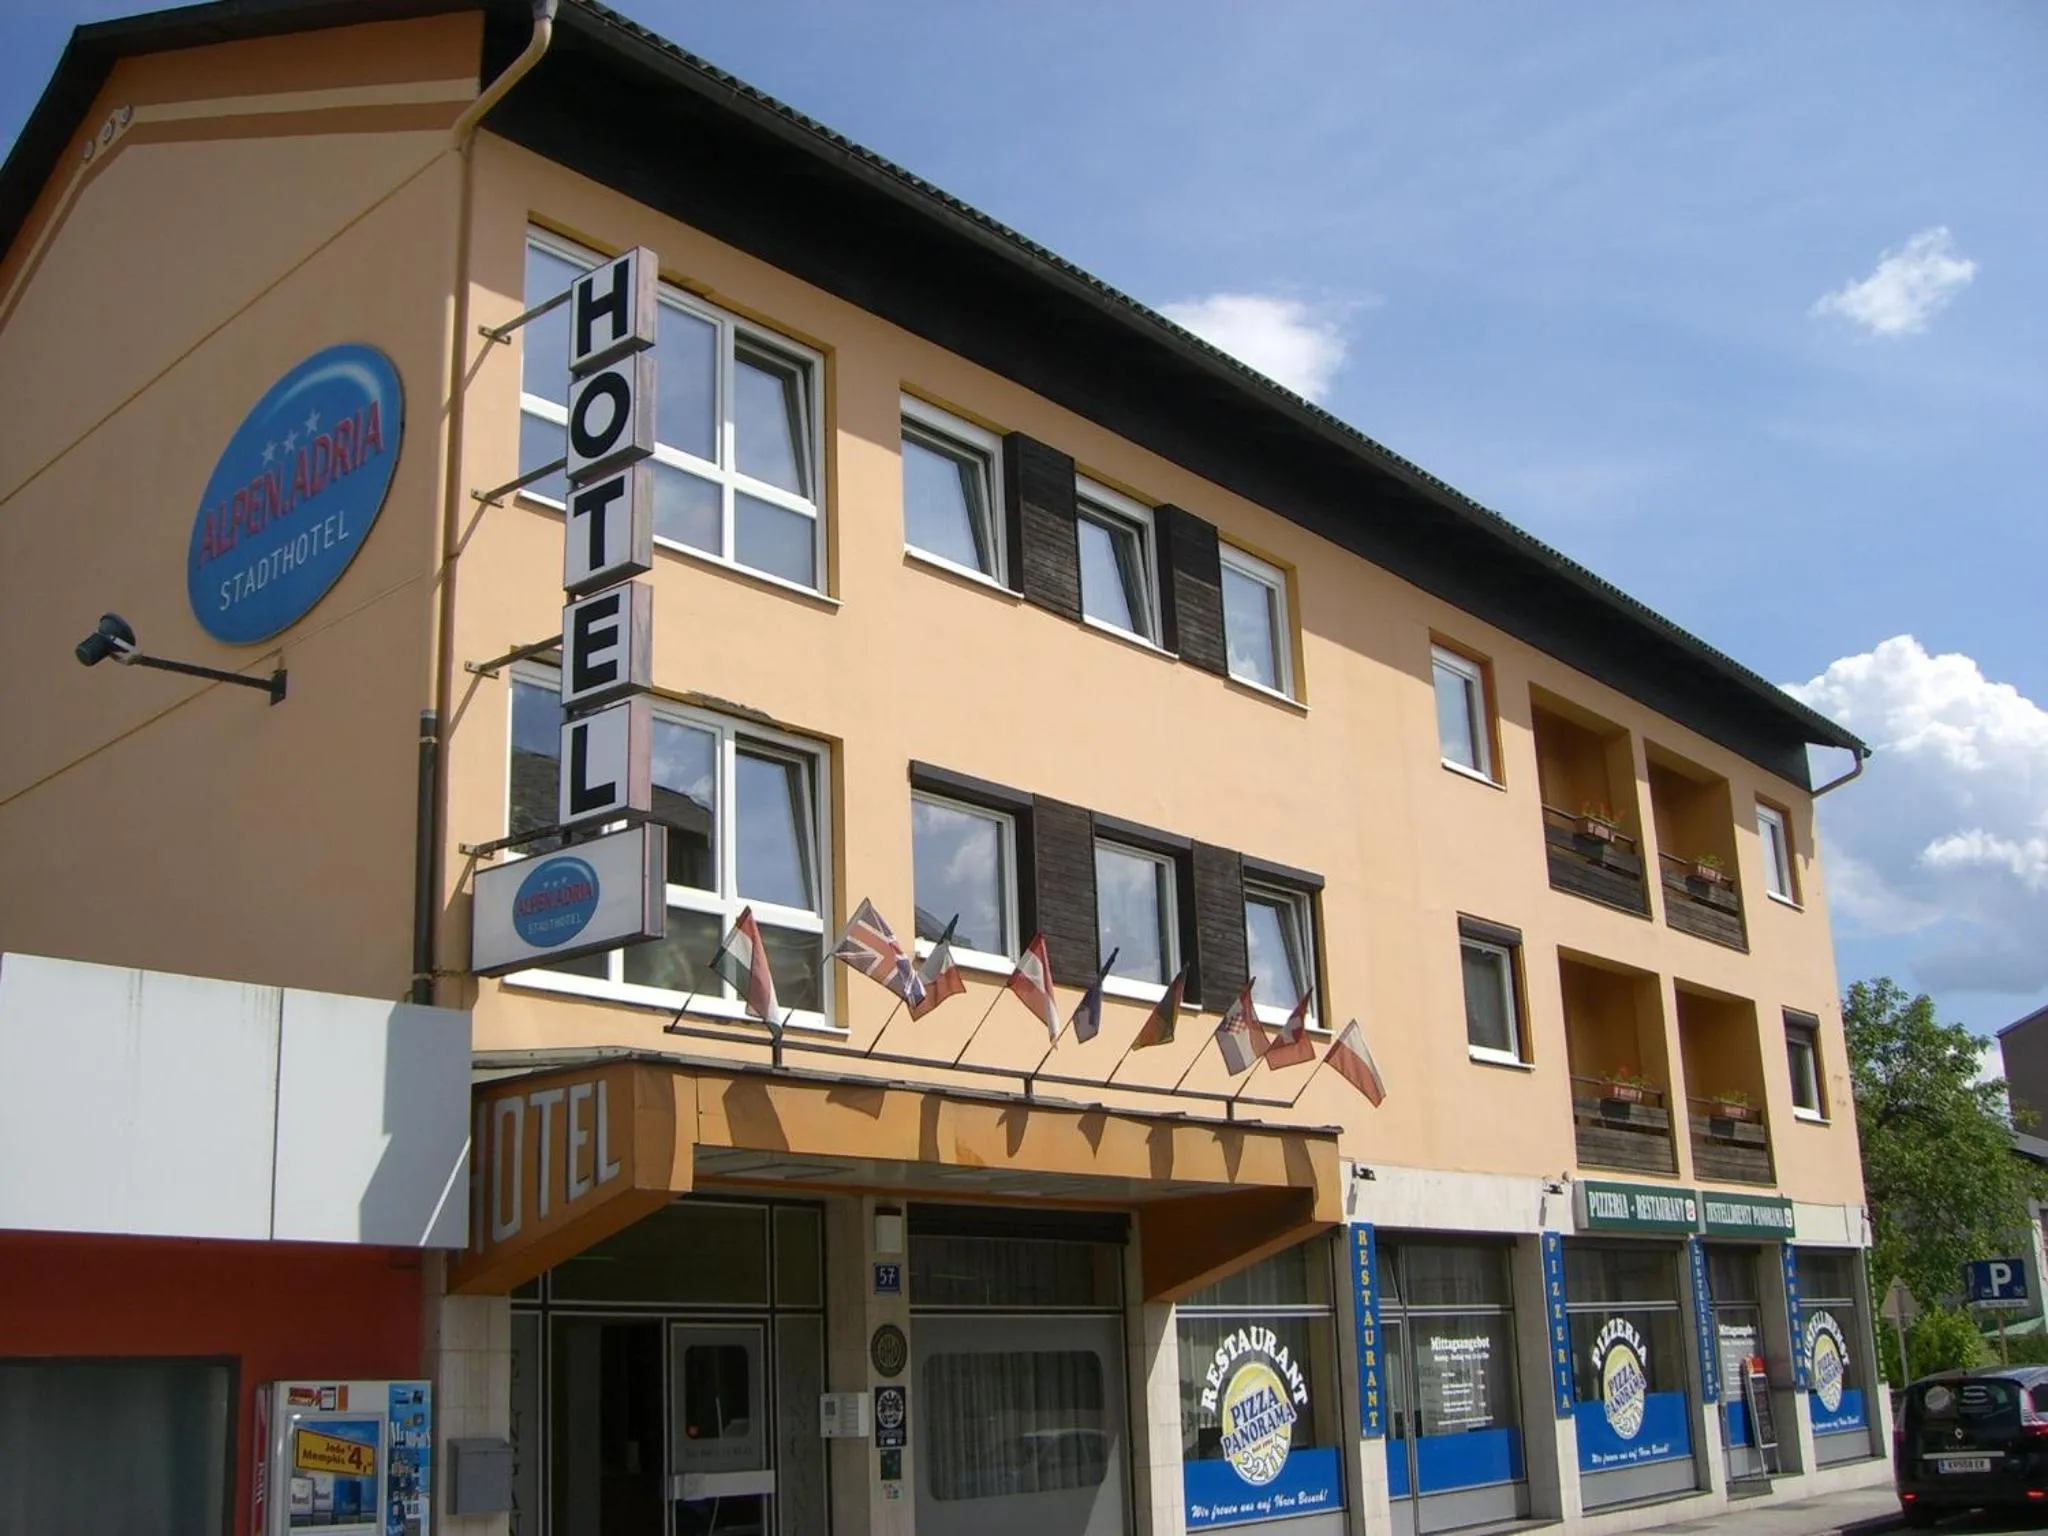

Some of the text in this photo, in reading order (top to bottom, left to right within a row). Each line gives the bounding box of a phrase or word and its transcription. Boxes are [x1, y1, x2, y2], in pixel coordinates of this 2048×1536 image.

[219, 510, 350, 611] STADTHOTEL
[569, 259, 630, 816] HOTEL
[1588, 1191, 1630, 1219] PIZZERIA
[1635, 1194, 1686, 1222] RESTAURANT
[879, 1267, 896, 1285] 57
[1989, 1263, 2012, 1297] P
[1358, 1229, 1378, 1428] RESTAURANT
[1548, 1237, 1570, 1409] PIZZERIA
[1592, 1317, 1646, 1370] PIZZERIA
[1201, 1325, 1308, 1412] RESTAURANT
[1223, 1403, 1295, 1457] PANORAMA
[1231, 1386, 1278, 1428] PIZZA
[302, 1448, 345, 1465] Memphis
[1191, 1504, 1209, 1518] Wir
[1256, 1497, 1271, 1513] auf
